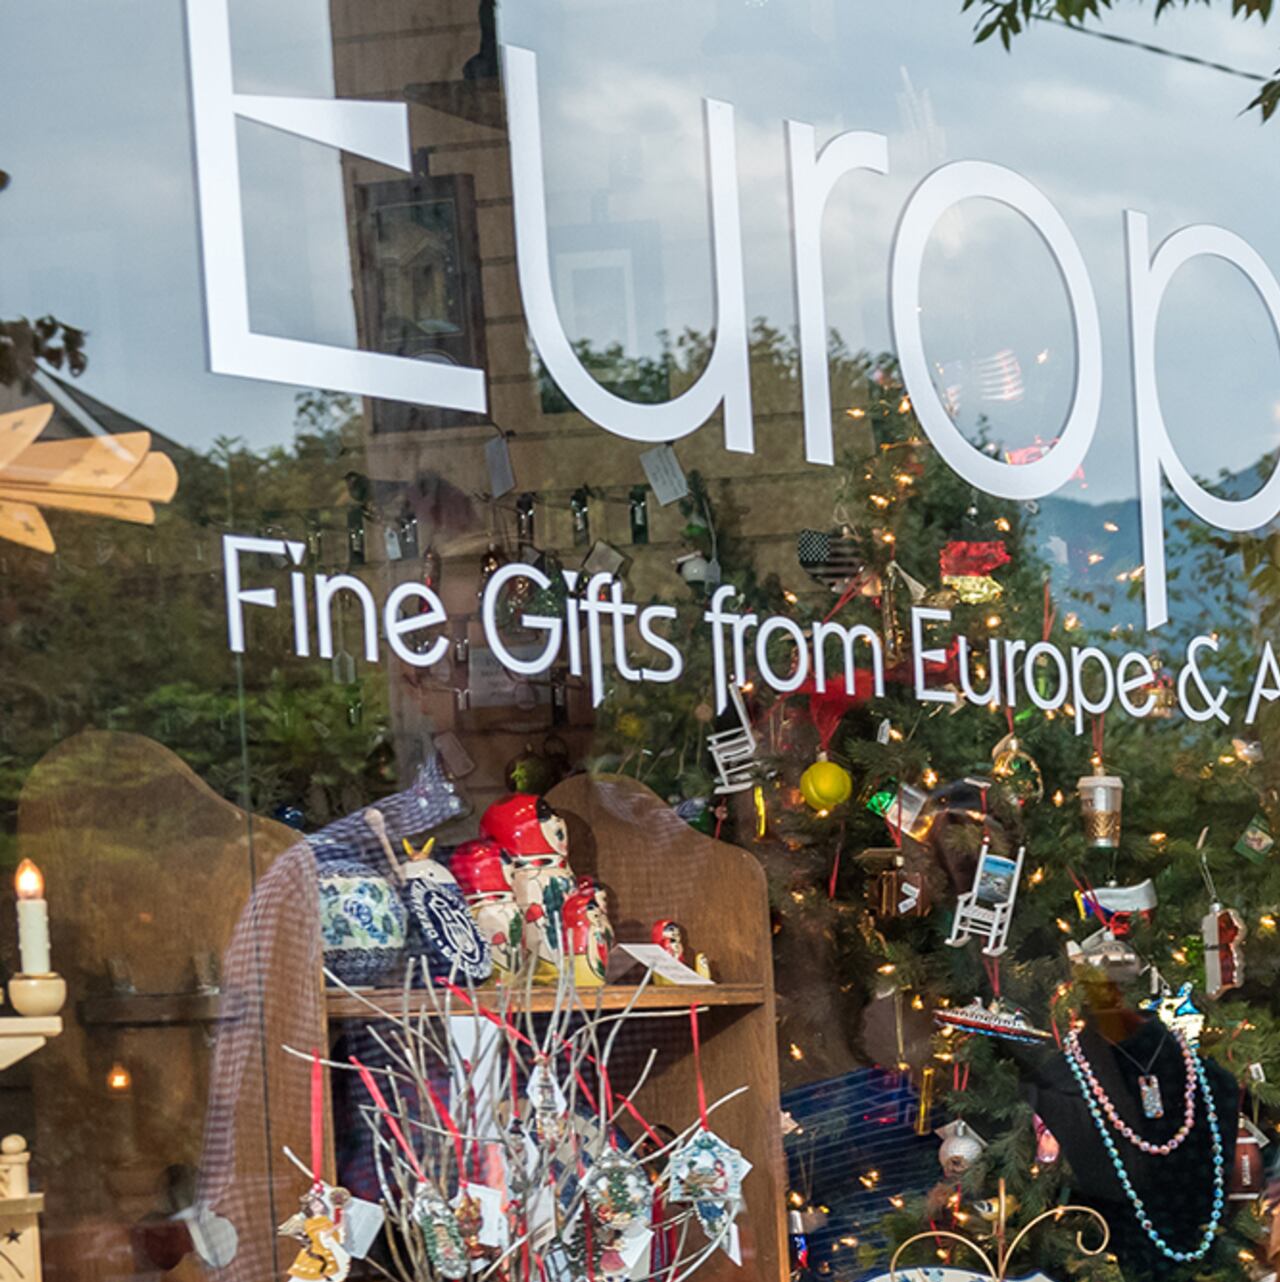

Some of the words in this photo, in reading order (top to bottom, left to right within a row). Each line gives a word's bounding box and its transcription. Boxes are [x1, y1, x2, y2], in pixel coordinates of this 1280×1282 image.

[222, 534, 450, 667] Fine
[483, 563, 683, 709] Gifts
[704, 585, 884, 716] from
[912, 607, 1158, 735] Europe
[1177, 636, 1231, 724] &
